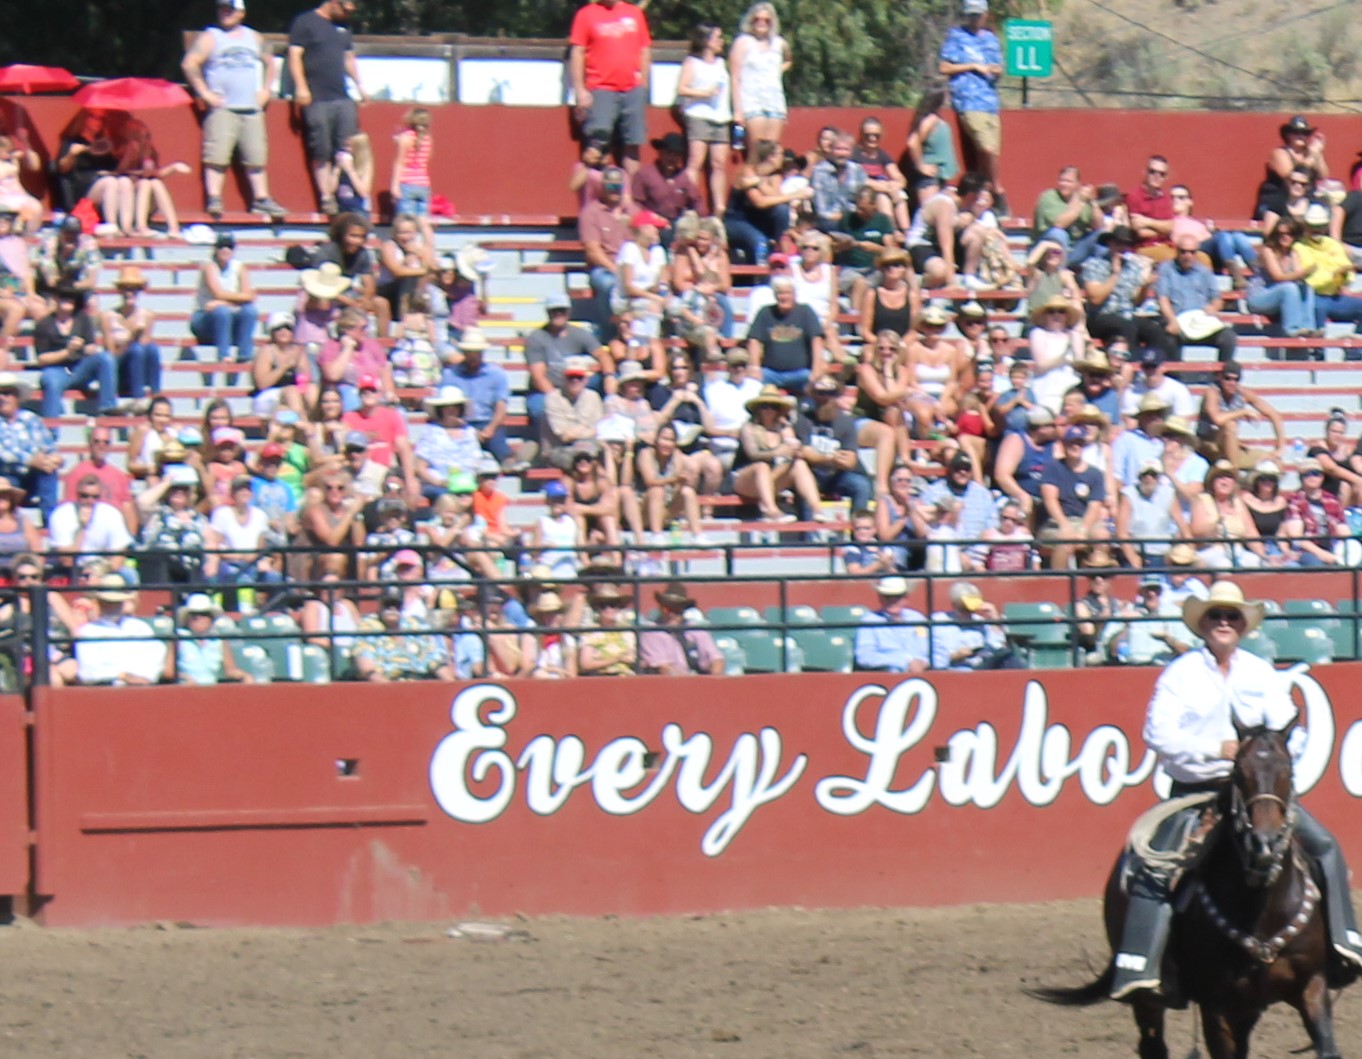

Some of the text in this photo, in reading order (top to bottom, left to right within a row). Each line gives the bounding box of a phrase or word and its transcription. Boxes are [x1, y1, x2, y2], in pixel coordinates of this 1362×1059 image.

[1016, 45, 1043, 71] LL
[428, 683, 807, 858] Every
[815, 677, 1174, 815] Labo
